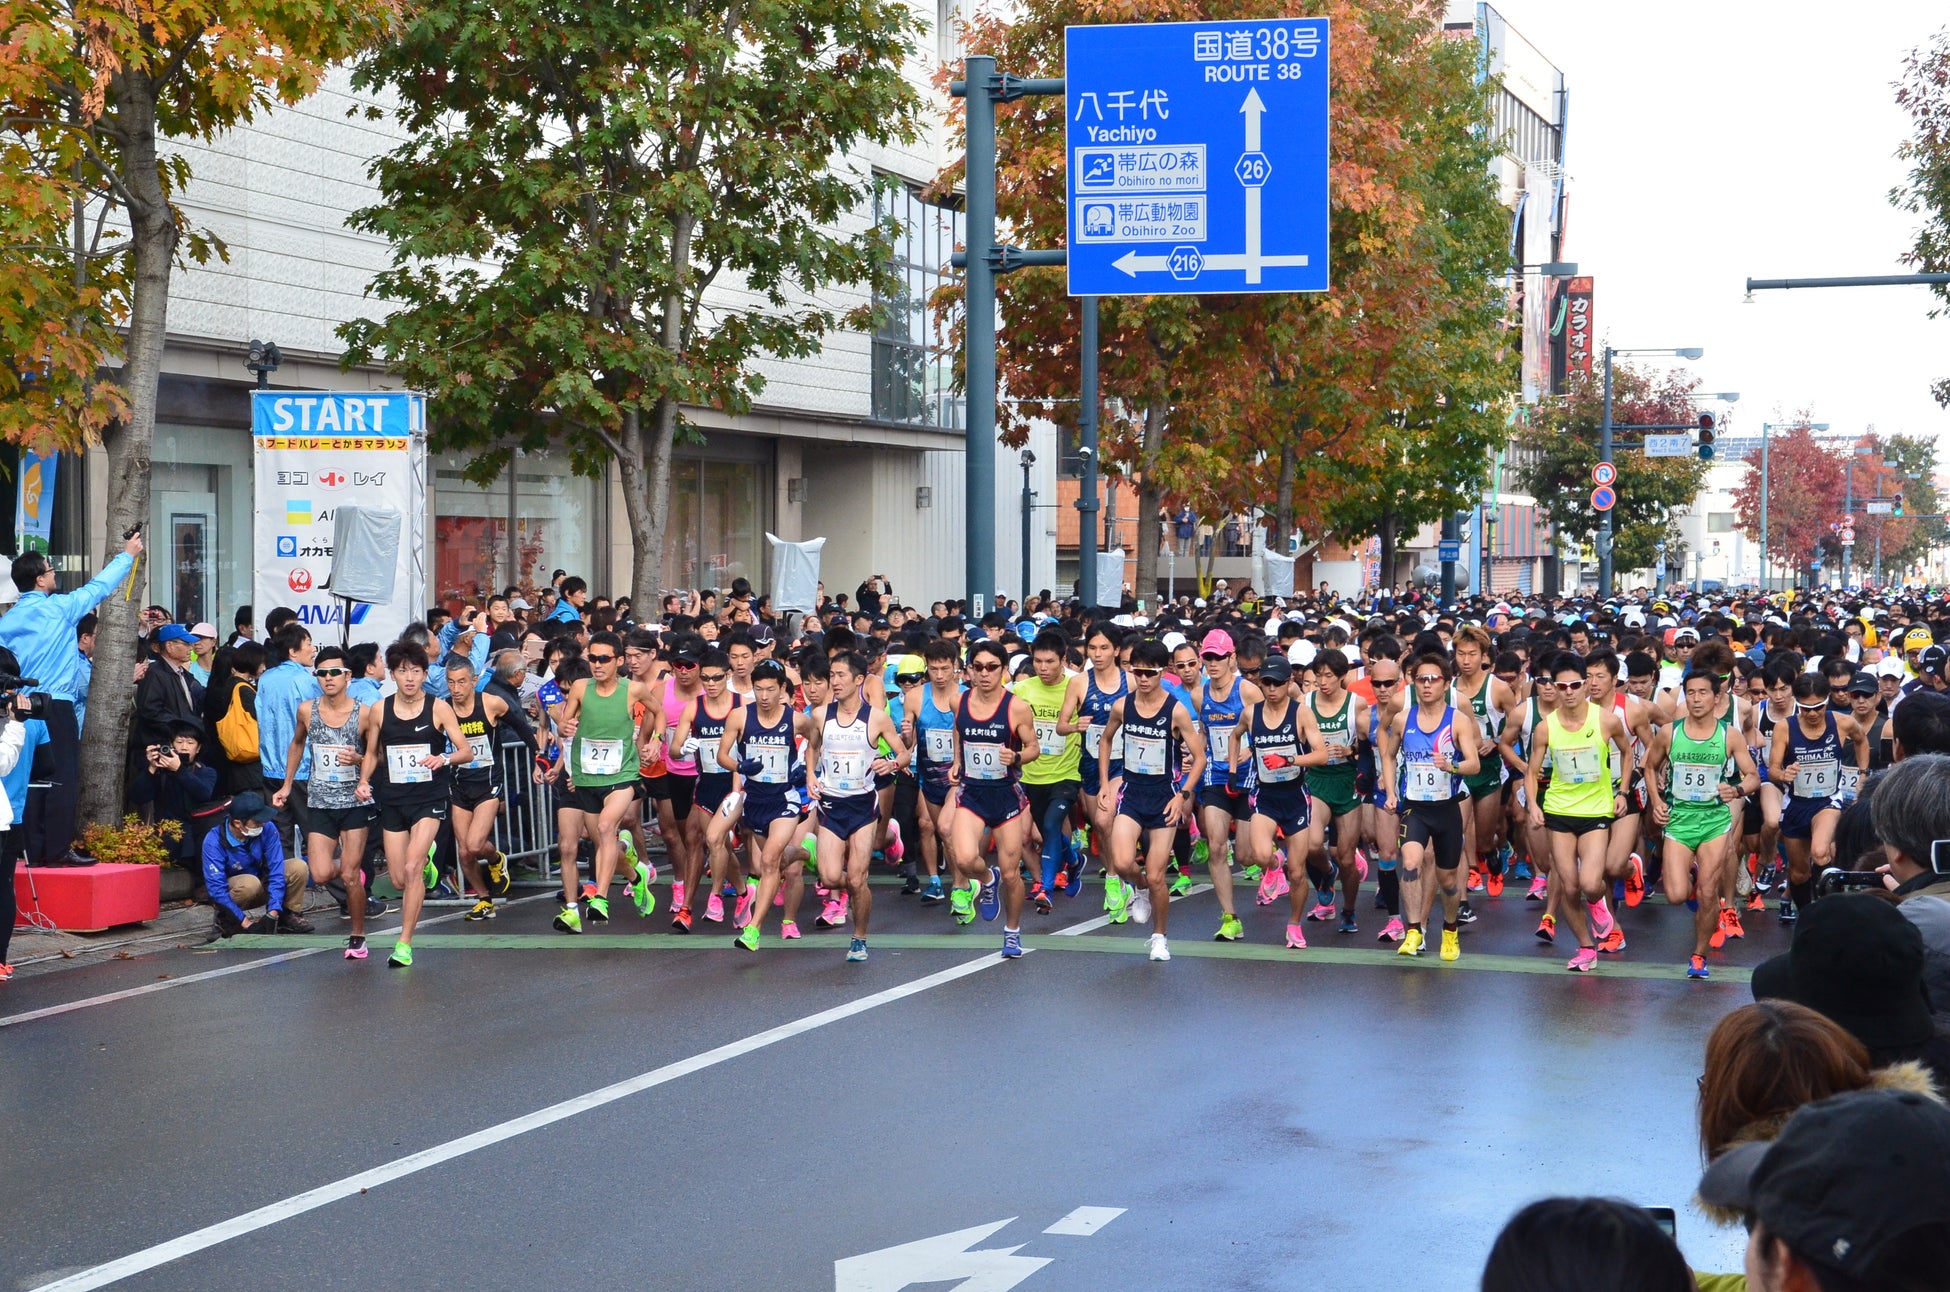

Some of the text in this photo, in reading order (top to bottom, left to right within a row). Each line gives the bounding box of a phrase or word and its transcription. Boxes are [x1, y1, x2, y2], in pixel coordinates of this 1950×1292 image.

[1194, 27, 1321, 61] 国道38号
[1205, 63, 1301, 82] ROUTE 38
[1075, 89, 1169, 121] 八千代
[1087, 125, 1157, 144] Yachiyo
[1118, 151, 1199, 172] 帯広の森
[1242, 160, 1263, 179] 26
[1118, 175, 1199, 186] Obihiro no mori
[1118, 202, 1199, 222] 帯広動物園
[1122, 225, 1196, 237] Obihiro Zoo
[1173, 255, 1198, 271] 216
[273, 397, 389, 432] START
[267, 439, 407, 449] フードバレーとかちマラソン
[354, 471, 386, 486] レイ
[300, 547, 333, 557] オカモ
[297, 605, 344, 625] ANA
[936, 738, 953, 749] 31
[591, 748, 609, 760] 27
[973, 753, 992, 765] 60
[1138, 747, 1145, 759] 7
[398, 755, 417, 768] 13
[833, 761, 850, 774] 21
[1571, 757, 1577, 769] 1
[1416, 773, 1434, 786] 18
[1685, 773, 1705, 786] 58
[1805, 773, 1824, 784] 76
